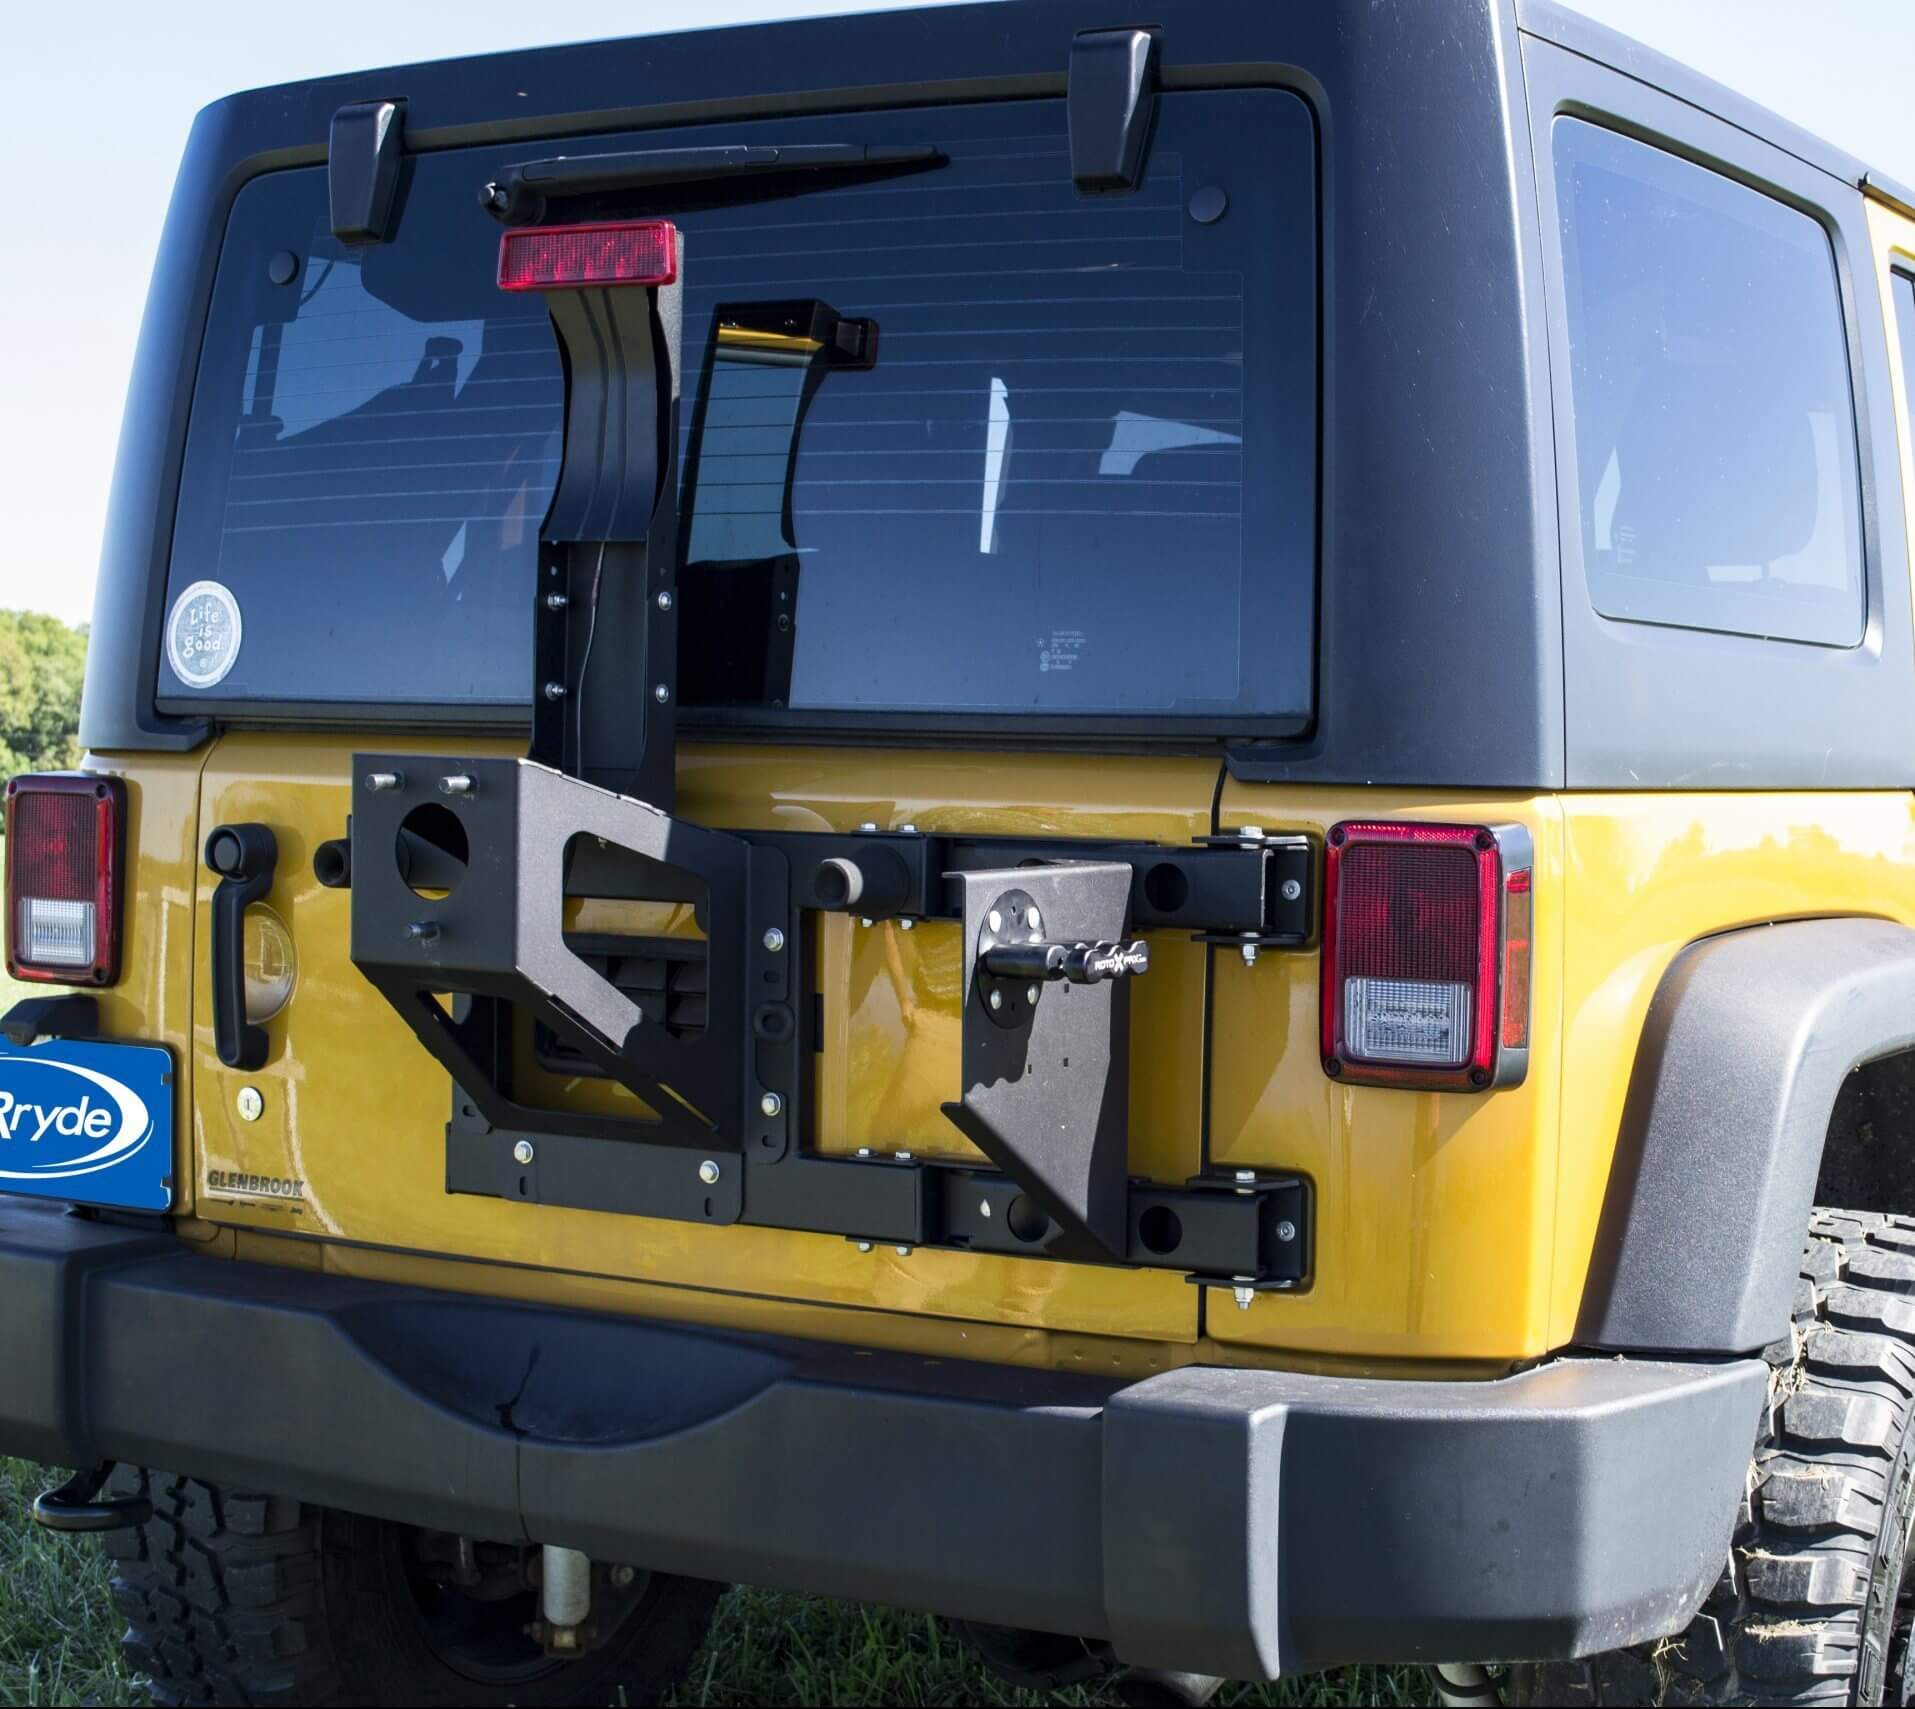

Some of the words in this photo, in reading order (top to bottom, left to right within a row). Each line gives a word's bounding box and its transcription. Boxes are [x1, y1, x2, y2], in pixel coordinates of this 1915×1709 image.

[190, 602, 219, 625] Life
[199, 624, 212, 637] is
[208, 1170, 304, 1196] GLENBROOK
